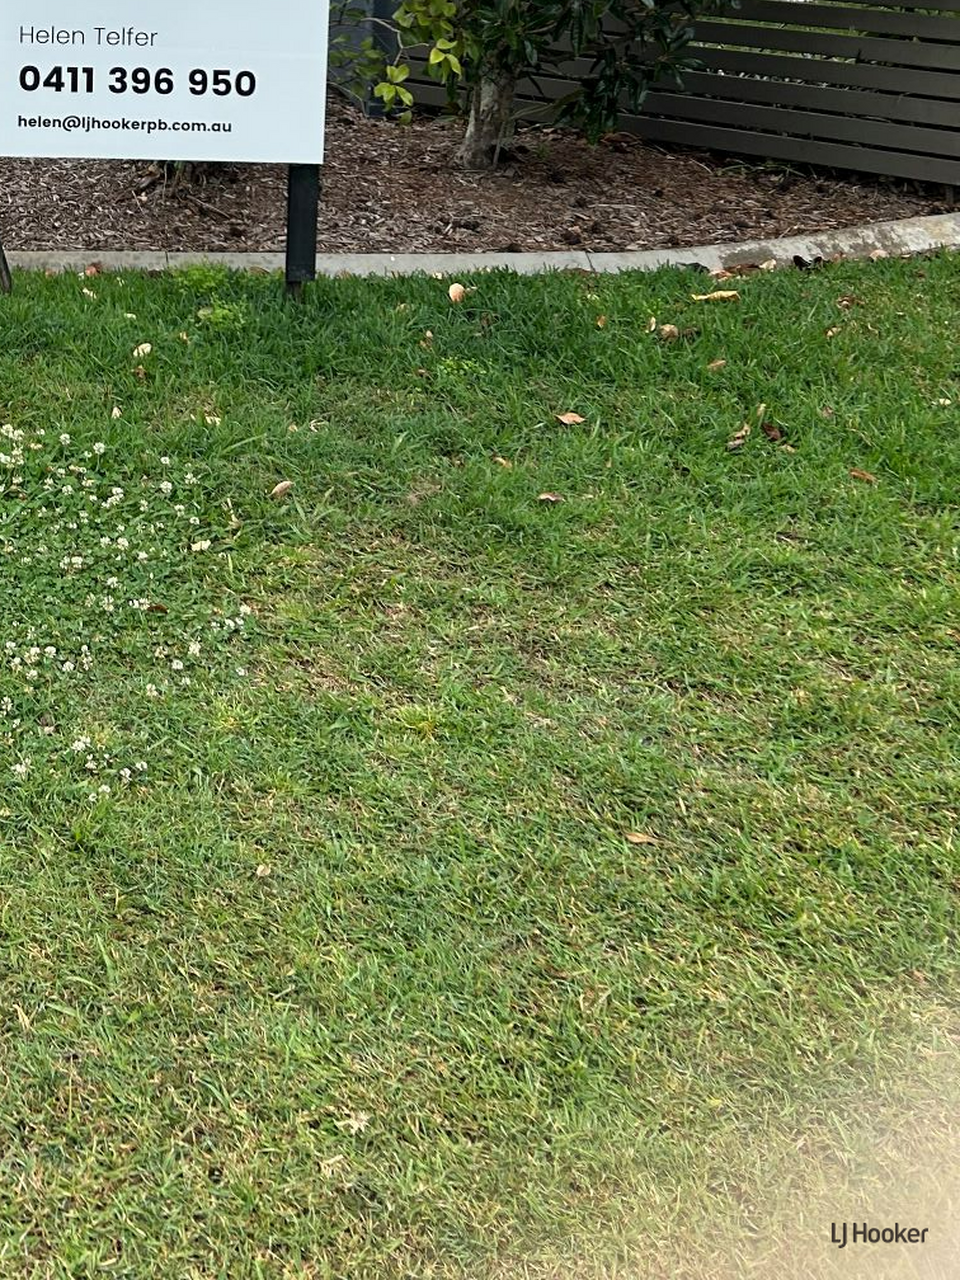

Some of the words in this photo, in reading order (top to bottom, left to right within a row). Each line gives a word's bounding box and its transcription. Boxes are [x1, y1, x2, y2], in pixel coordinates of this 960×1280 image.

[19, 25, 85, 45] Helen
[93, 26, 158, 46] Telfer
[19, 65, 94, 93] 0411
[108, 66, 174, 94] 396
[188, 68, 256, 97] 950
[17, 115, 232, 134] helen@ljhookerpb.com.au
